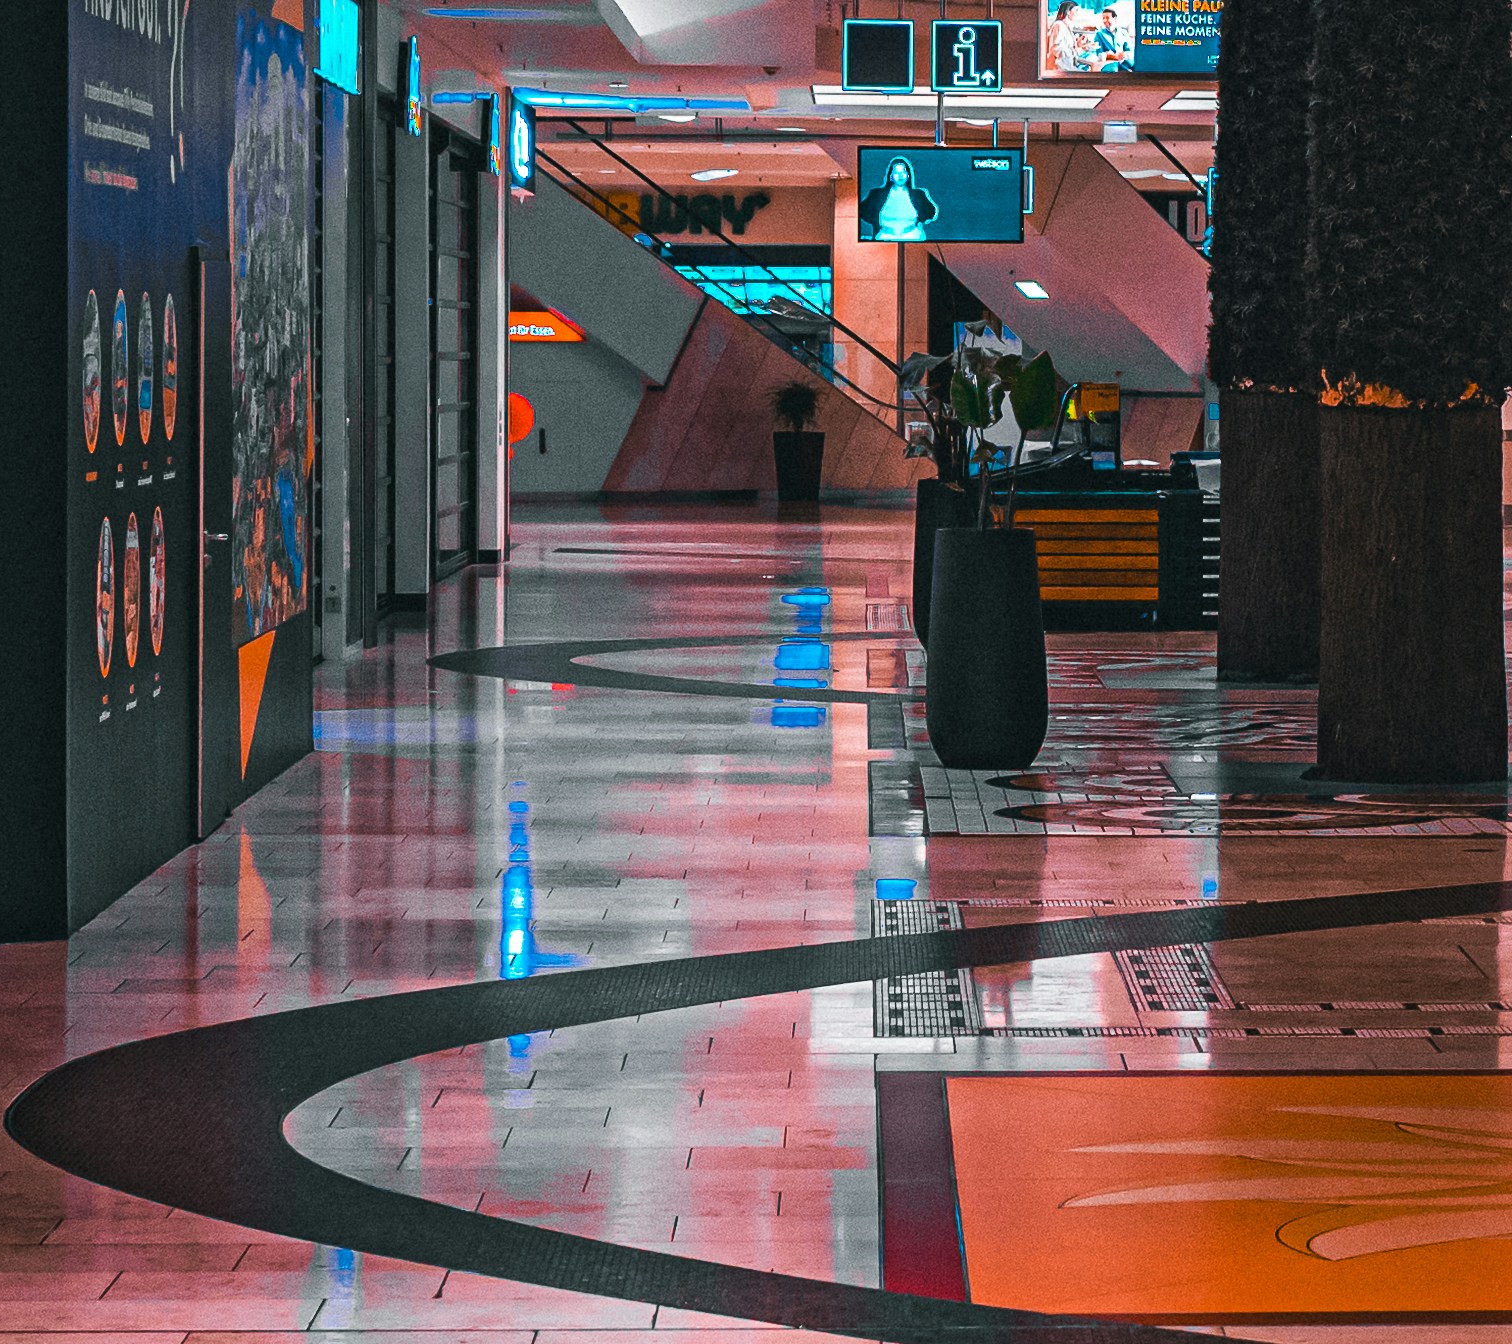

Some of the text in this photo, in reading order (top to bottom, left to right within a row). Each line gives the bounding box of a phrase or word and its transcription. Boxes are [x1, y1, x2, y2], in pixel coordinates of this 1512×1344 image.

[1140, 0, 1190, 13] KLEINE
[1140, 12, 1217, 25] FEINE KÜCHE.
[1140, 25, 1172, 36] FEINE
